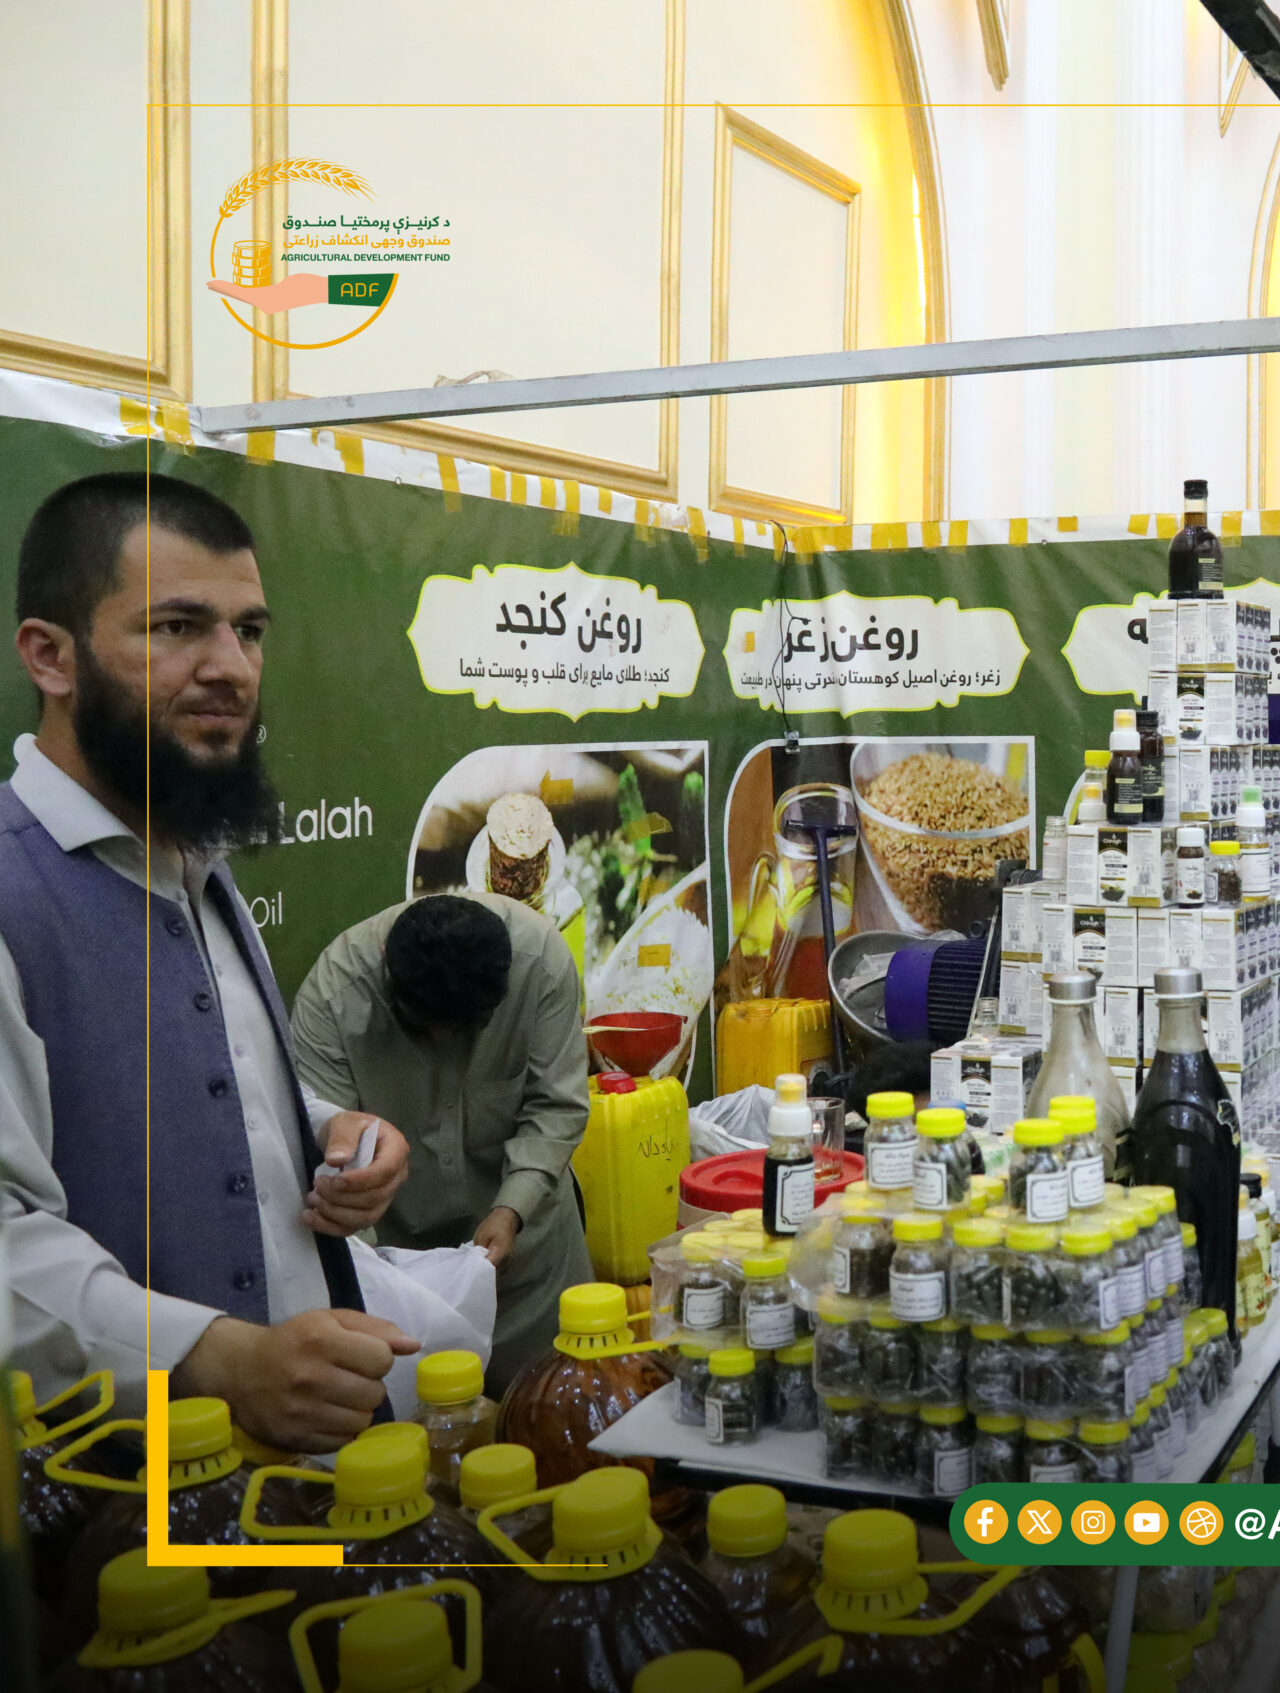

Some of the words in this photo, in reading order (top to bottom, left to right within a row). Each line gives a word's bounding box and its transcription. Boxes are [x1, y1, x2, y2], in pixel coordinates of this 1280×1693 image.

[496, 591, 567, 650] کنجد
[577, 597, 642, 653] روغن
[783, 616, 828, 663] زغر
[831, 615, 918, 663] روغن
[460, 657, 485, 678] شما
[488, 662, 528, 687] پوست
[532, 671, 539, 683] و
[542, 662, 566, 683] قلب
[569, 662, 588, 684] برای
[590, 665, 613, 688] مایع
[616, 664, 642, 683] طلای
[903, 669, 937, 688] اصیل
[765, 676, 773, 690] در
[774, 673, 802, 692] پنهان
[939, 671, 972, 688] روغن
[279, 797, 373, 844] Lalah
[250, 891, 282, 928] Oil
